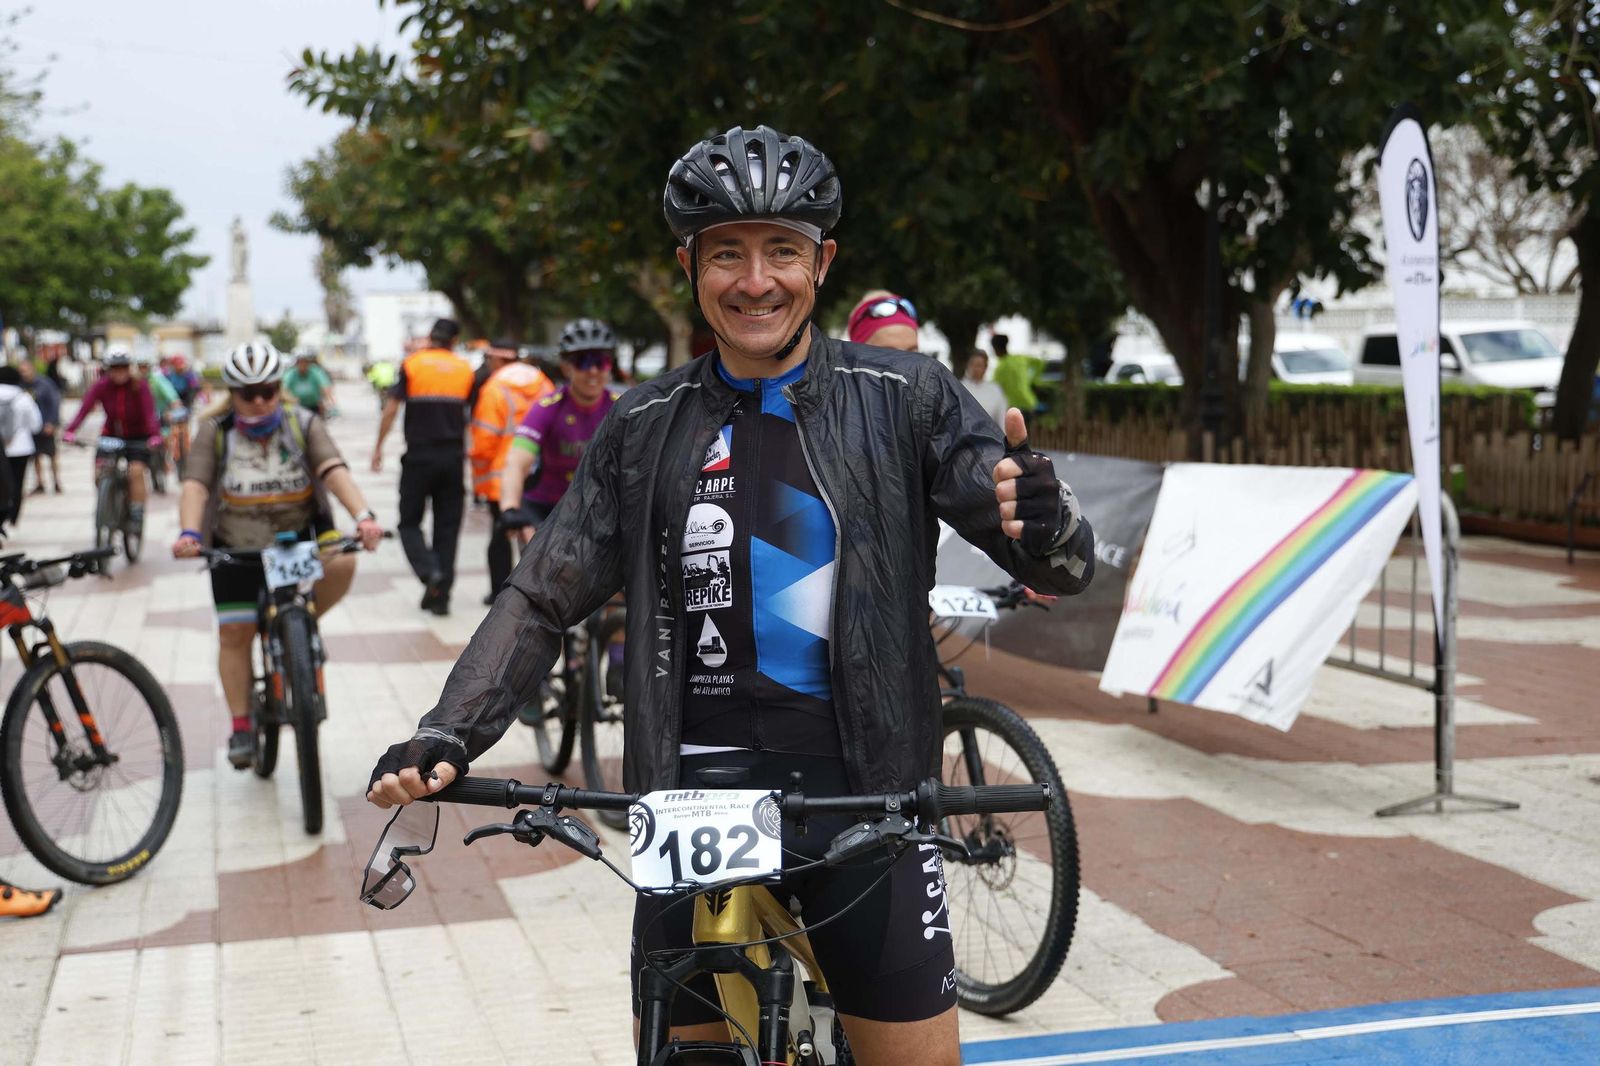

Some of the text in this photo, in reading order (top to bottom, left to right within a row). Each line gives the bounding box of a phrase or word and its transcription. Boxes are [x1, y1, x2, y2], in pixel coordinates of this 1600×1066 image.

[705, 476, 735, 493] ARPE
[688, 539, 715, 548] SERVICIOS
[686, 585, 731, 606] REPIKE
[942, 597, 988, 613] 122
[712, 674, 734, 684] PLAYAS
[691, 810, 712, 818] MTB
[658, 824, 760, 884] 182
